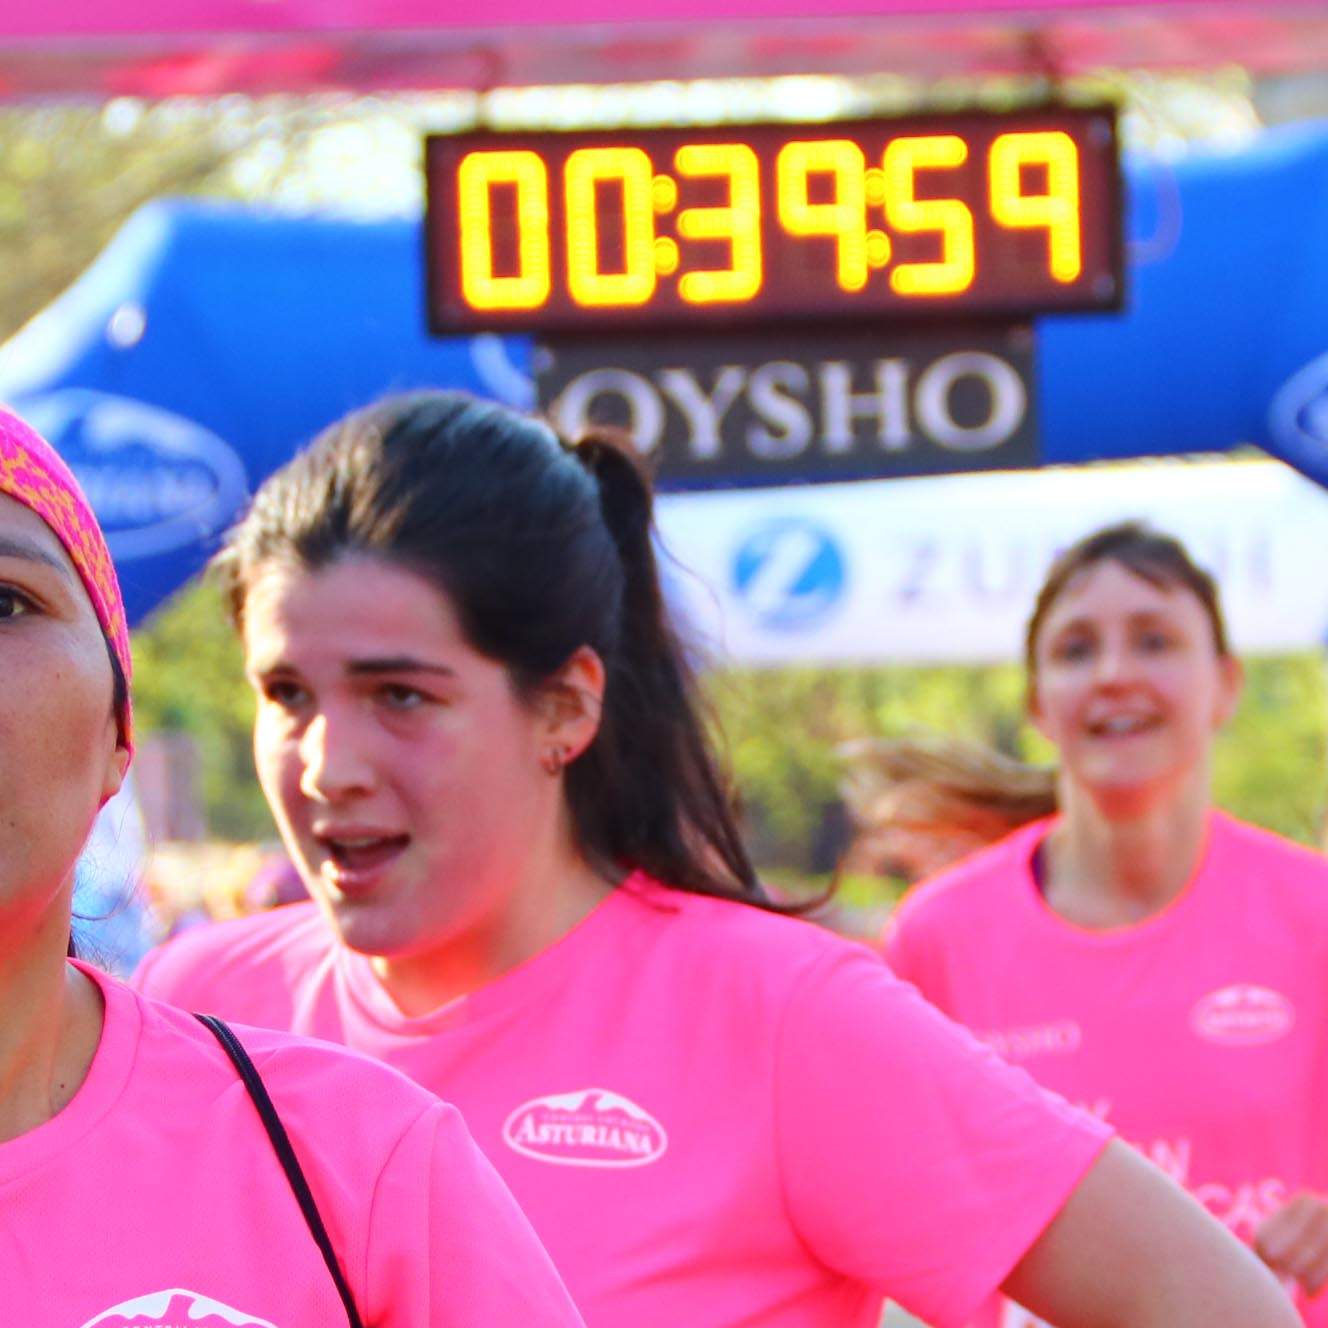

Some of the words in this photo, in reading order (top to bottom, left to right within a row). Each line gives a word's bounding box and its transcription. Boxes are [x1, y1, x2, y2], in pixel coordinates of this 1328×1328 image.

[458, 130, 1082, 310] 00:39:59
[556, 351, 1028, 460] OYSHO
[513, 1112, 654, 1155] ASTURIANA
